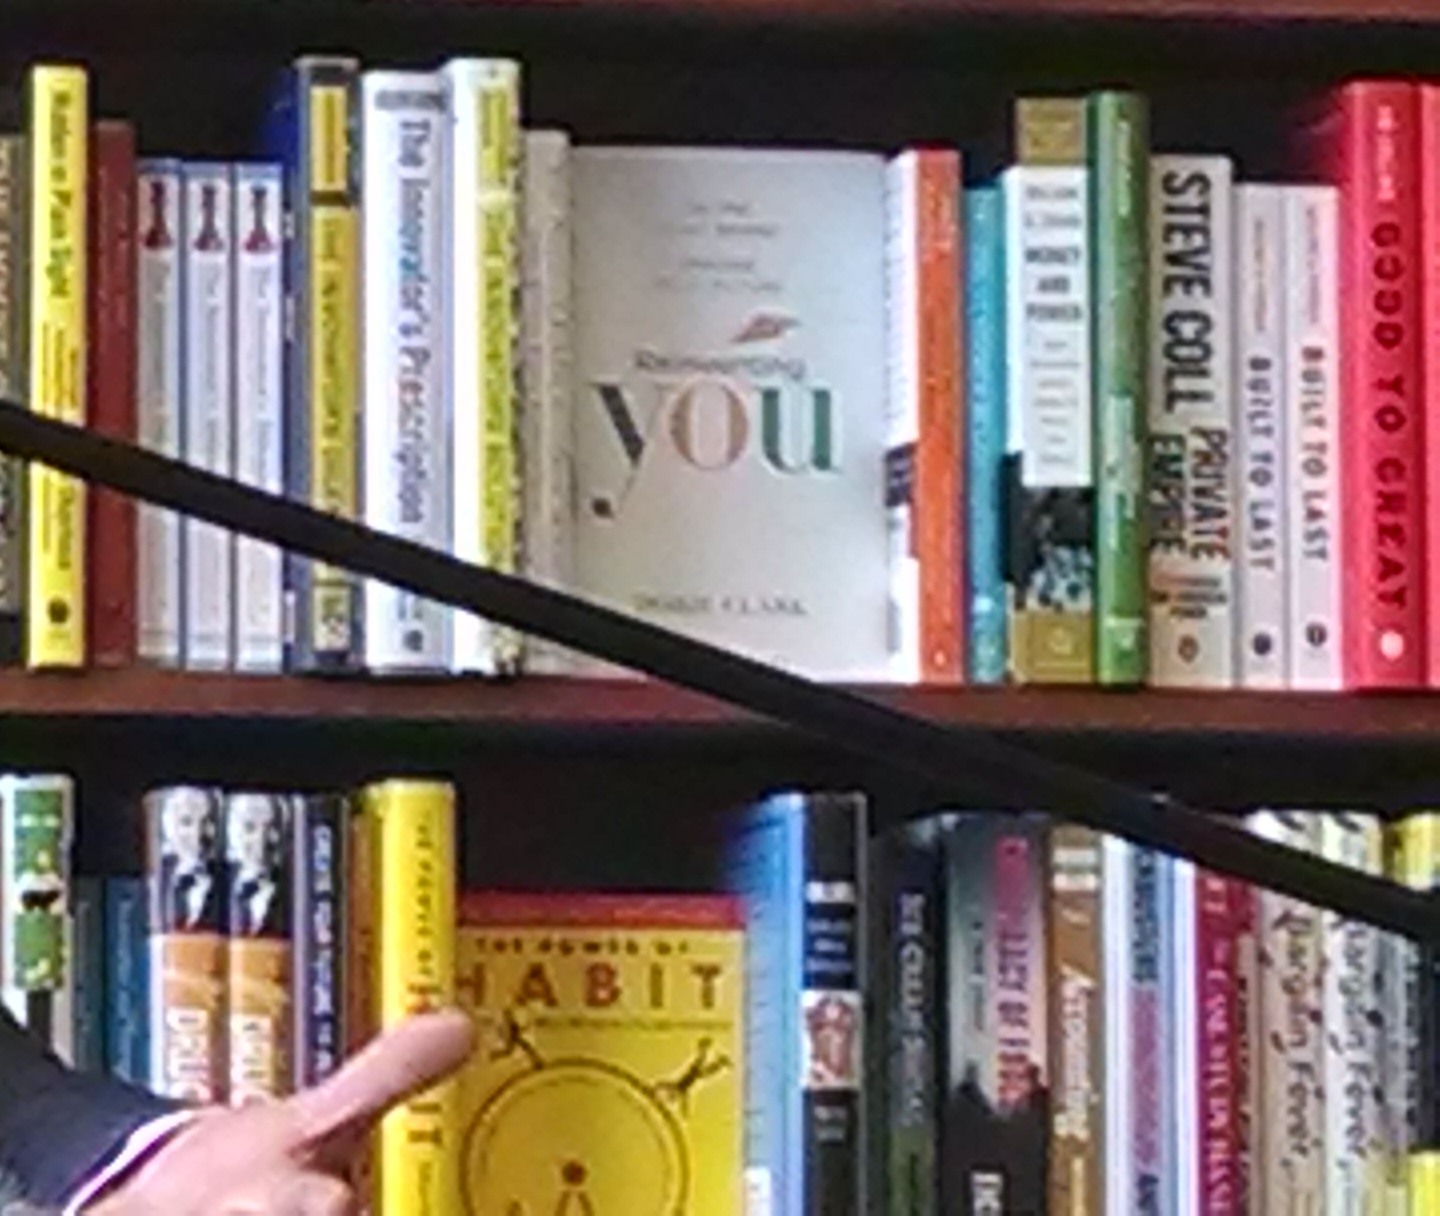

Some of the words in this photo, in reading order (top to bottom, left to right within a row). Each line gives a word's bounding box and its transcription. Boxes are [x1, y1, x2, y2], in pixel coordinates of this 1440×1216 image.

[399, 119, 431, 168] The
[398, 176, 432, 337] Innovator's
[1162, 170, 1212, 297] STEVE
[1370, 221, 1404, 351] GOOD
[1163, 308, 1211, 413] COLL
[1246, 355, 1272, 439] BUILT
[1301, 345, 1326, 430] BUILT
[1375, 374, 1405, 433] TO
[394, 346, 433, 525] Prescription
[587, 381, 844, 520] you
[1246, 450, 1272, 488] TO
[1302, 441, 1326, 478] TO
[1149, 434, 1189, 554] EMPIRE
[1189, 426, 1229, 561] PRIVATE
[1247, 499, 1273, 570] LAST
[1302, 489, 1328, 564] LAST
[1375, 457, 1407, 609] GREAT
[453, 963, 722, 1009] HABIT
[1051, 964, 1098, 1139] Accounting
